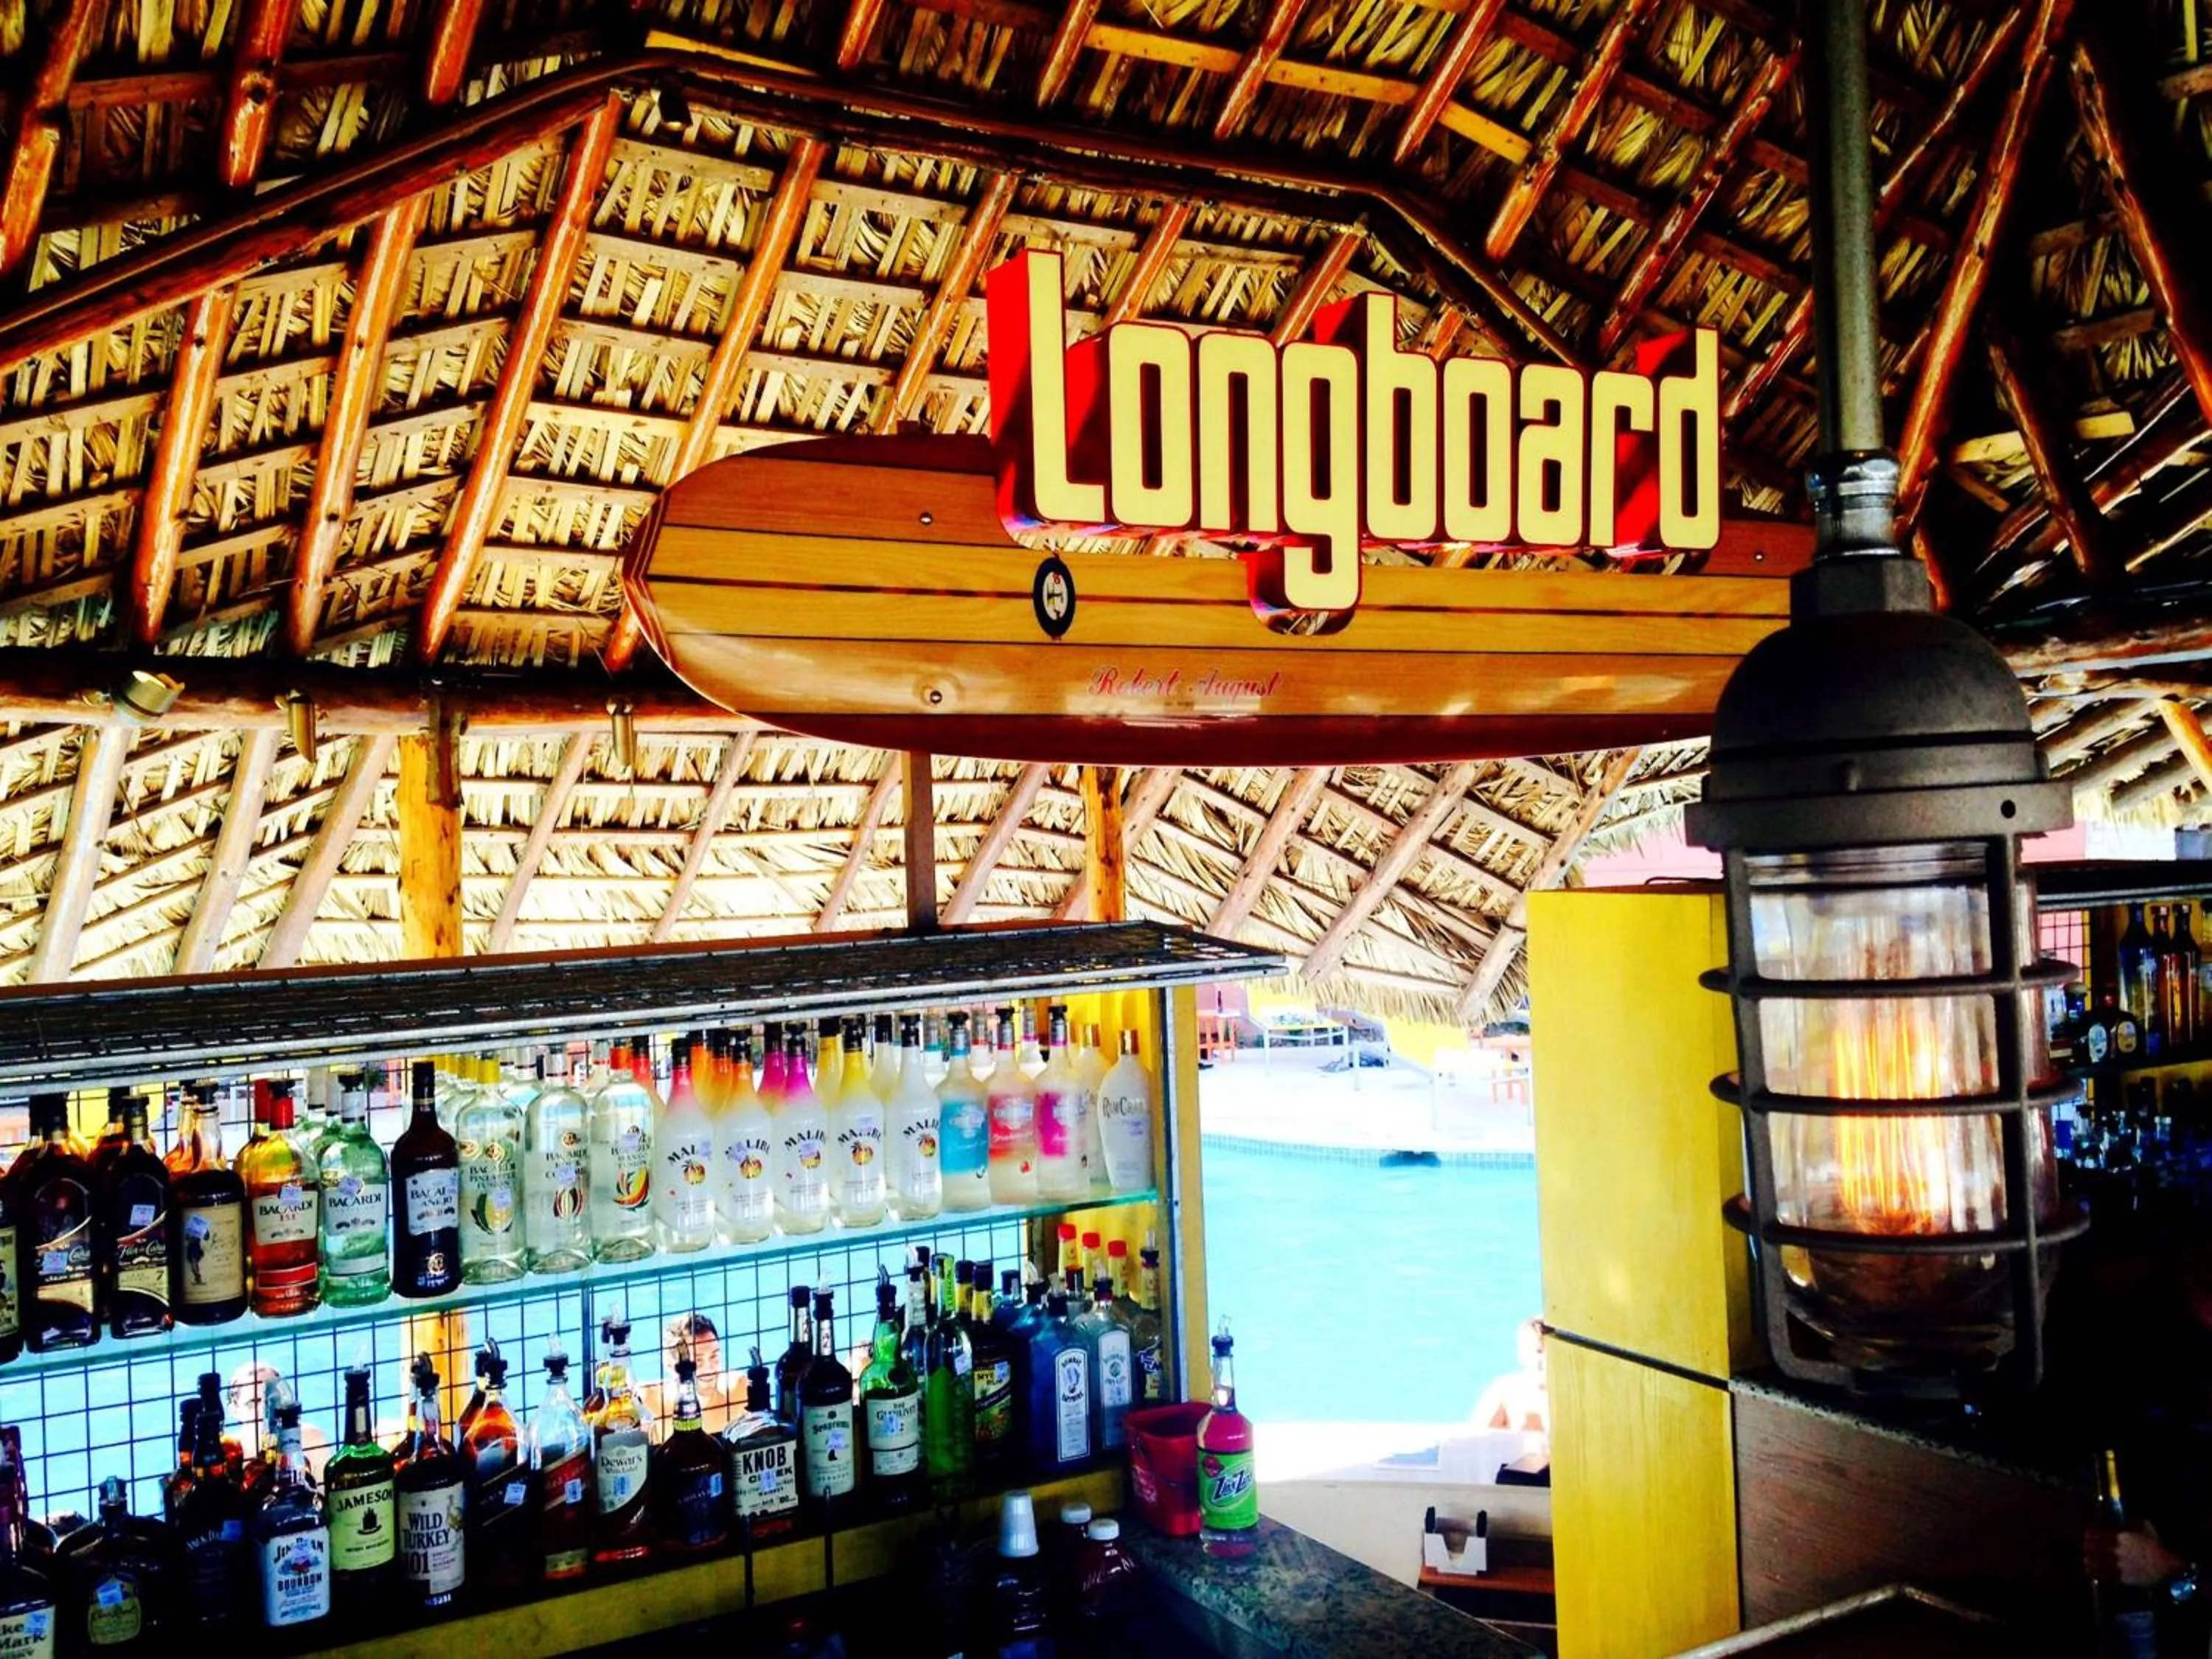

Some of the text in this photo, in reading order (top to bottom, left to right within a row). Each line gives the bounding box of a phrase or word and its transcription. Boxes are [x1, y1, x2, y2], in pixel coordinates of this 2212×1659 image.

[1026, 249, 1719, 611] Longboard
[1088, 666, 1281, 702] Robert August
[328, 1192, 381, 1208] BACARDI
[742, 1445, 787, 1475] KNOB
[408, 1512, 442, 1531] WILD
[403, 1528, 451, 1551] TURKEY
